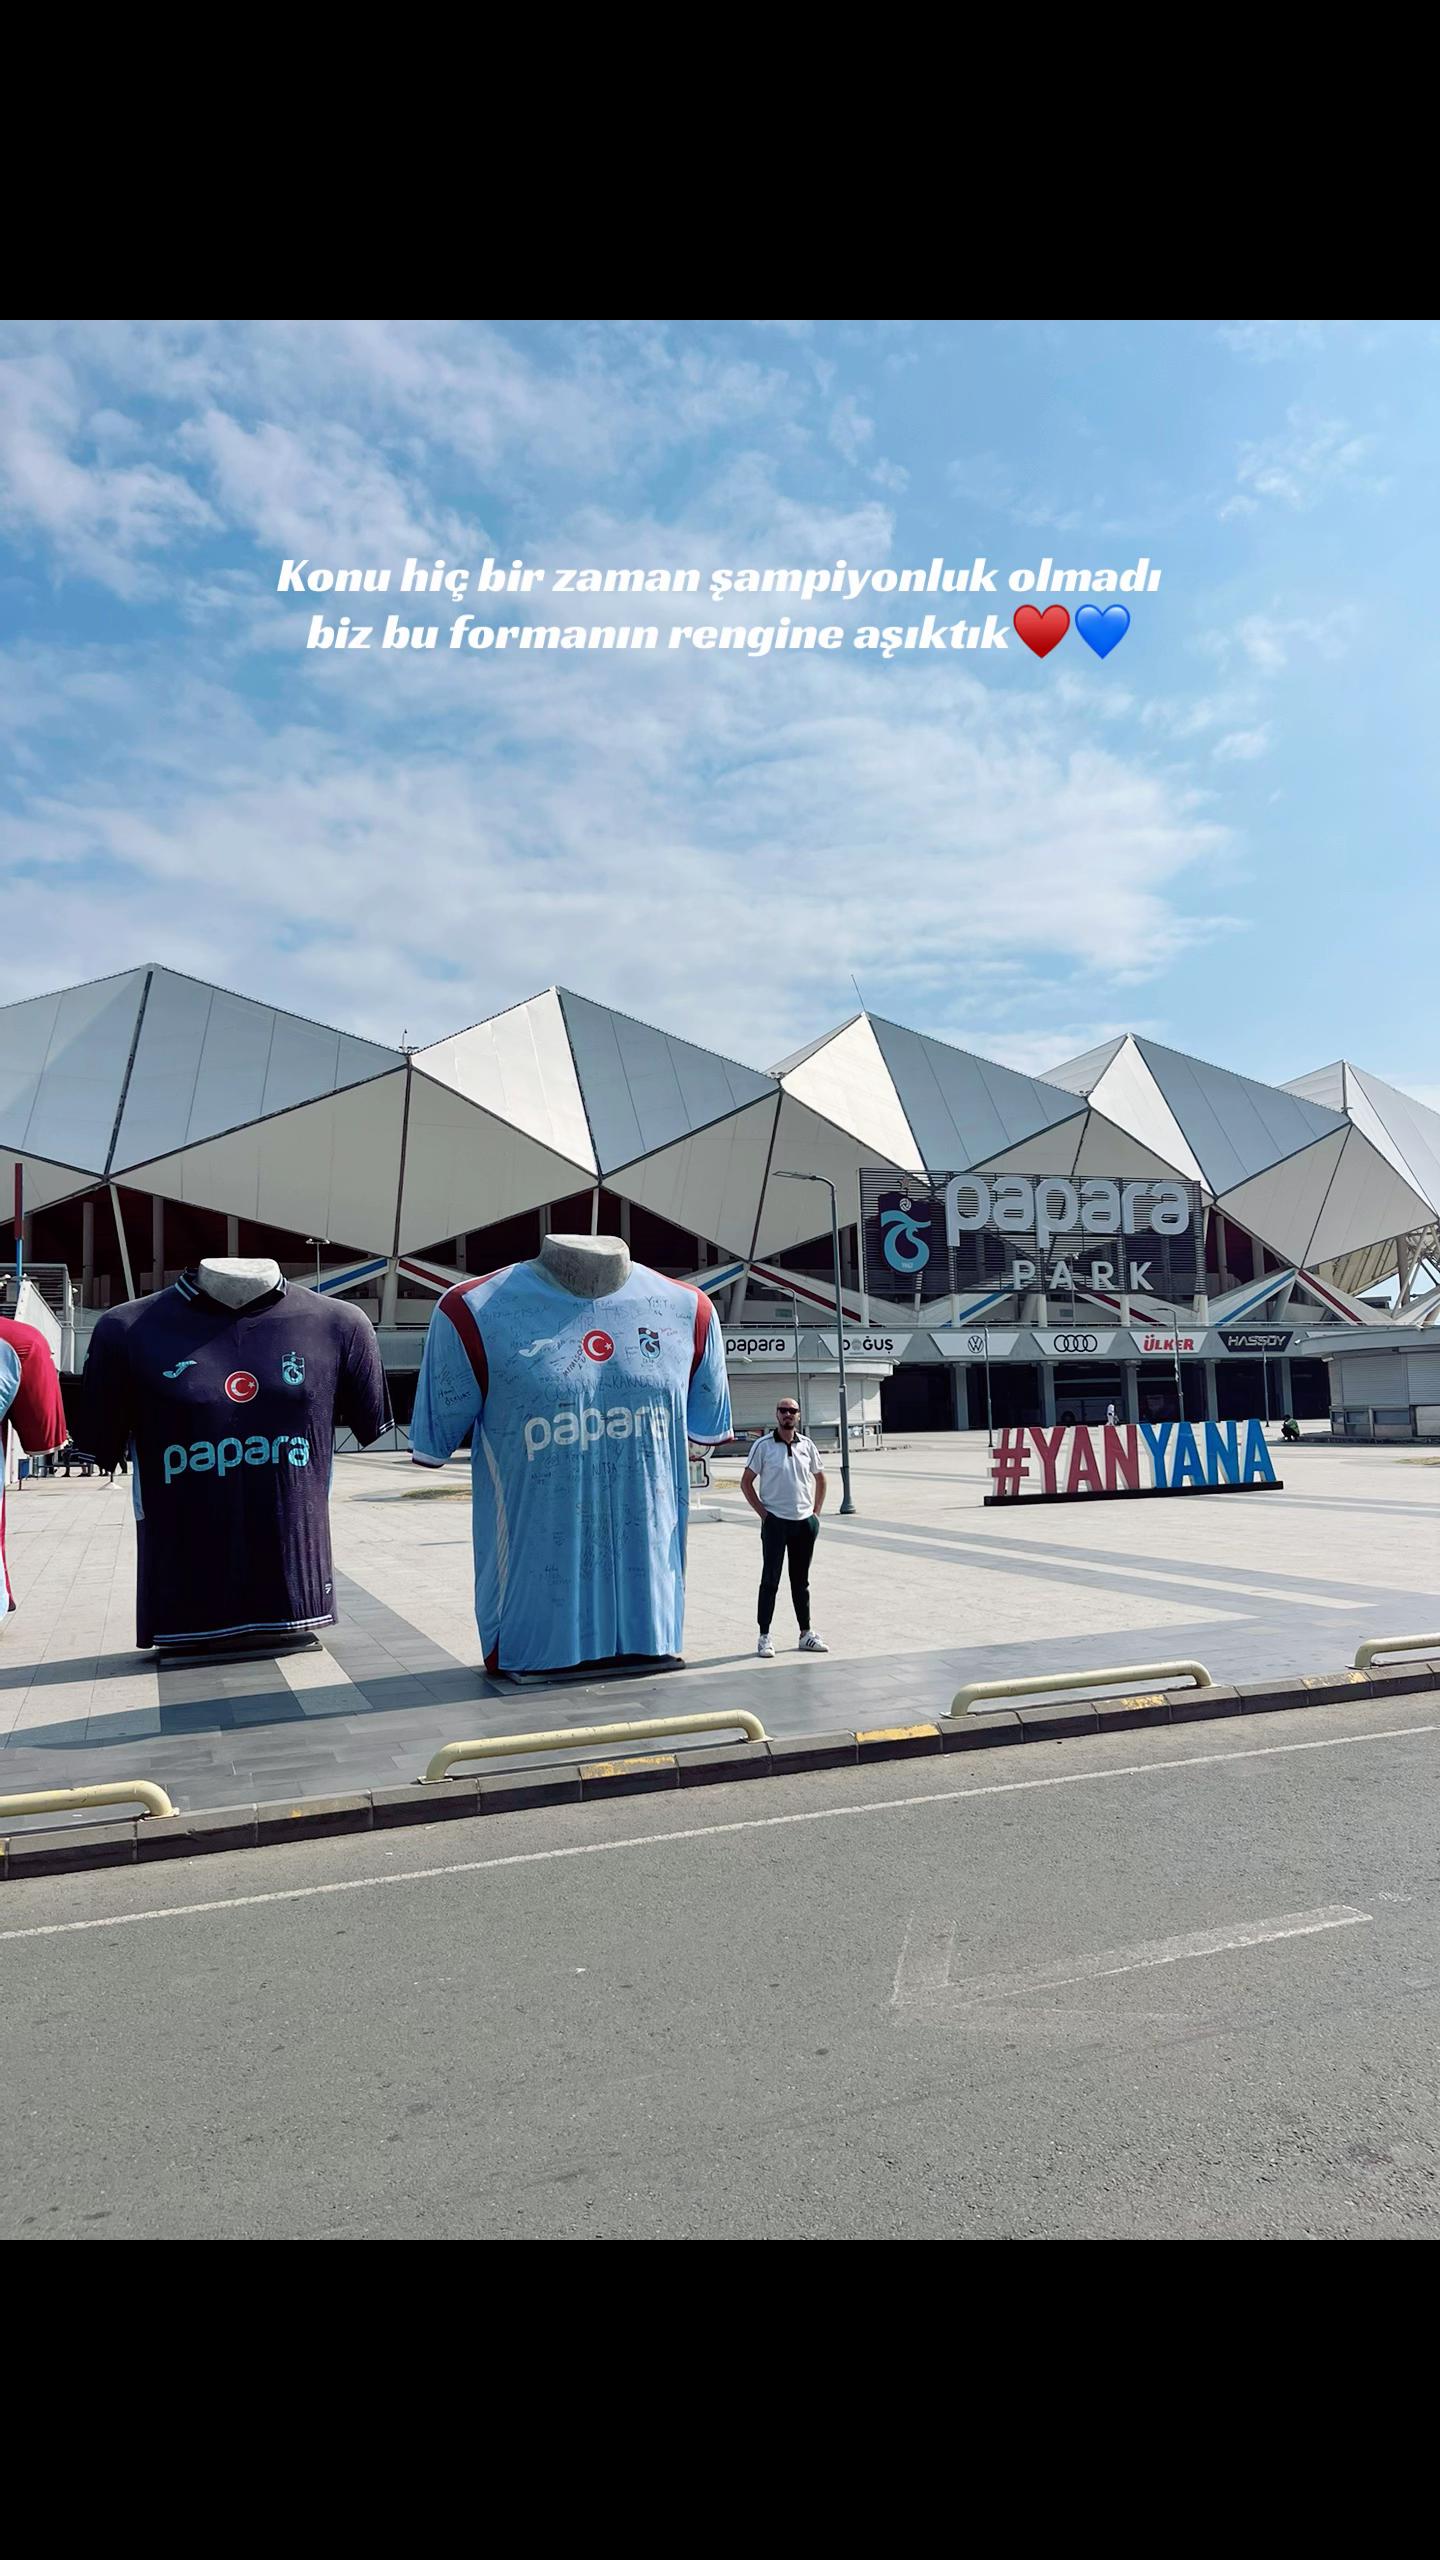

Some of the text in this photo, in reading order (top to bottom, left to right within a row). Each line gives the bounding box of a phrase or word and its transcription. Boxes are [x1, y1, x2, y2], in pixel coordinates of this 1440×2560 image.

[945, 1174, 1190, 1249] papara
[1012, 1260, 1154, 1290] PARK
[725, 1338, 785, 1355] papara
[1143, 1334, 1194, 1351] ÜLKER
[524, 1406, 671, 1462] papara
[163, 1435, 310, 1484] papara
